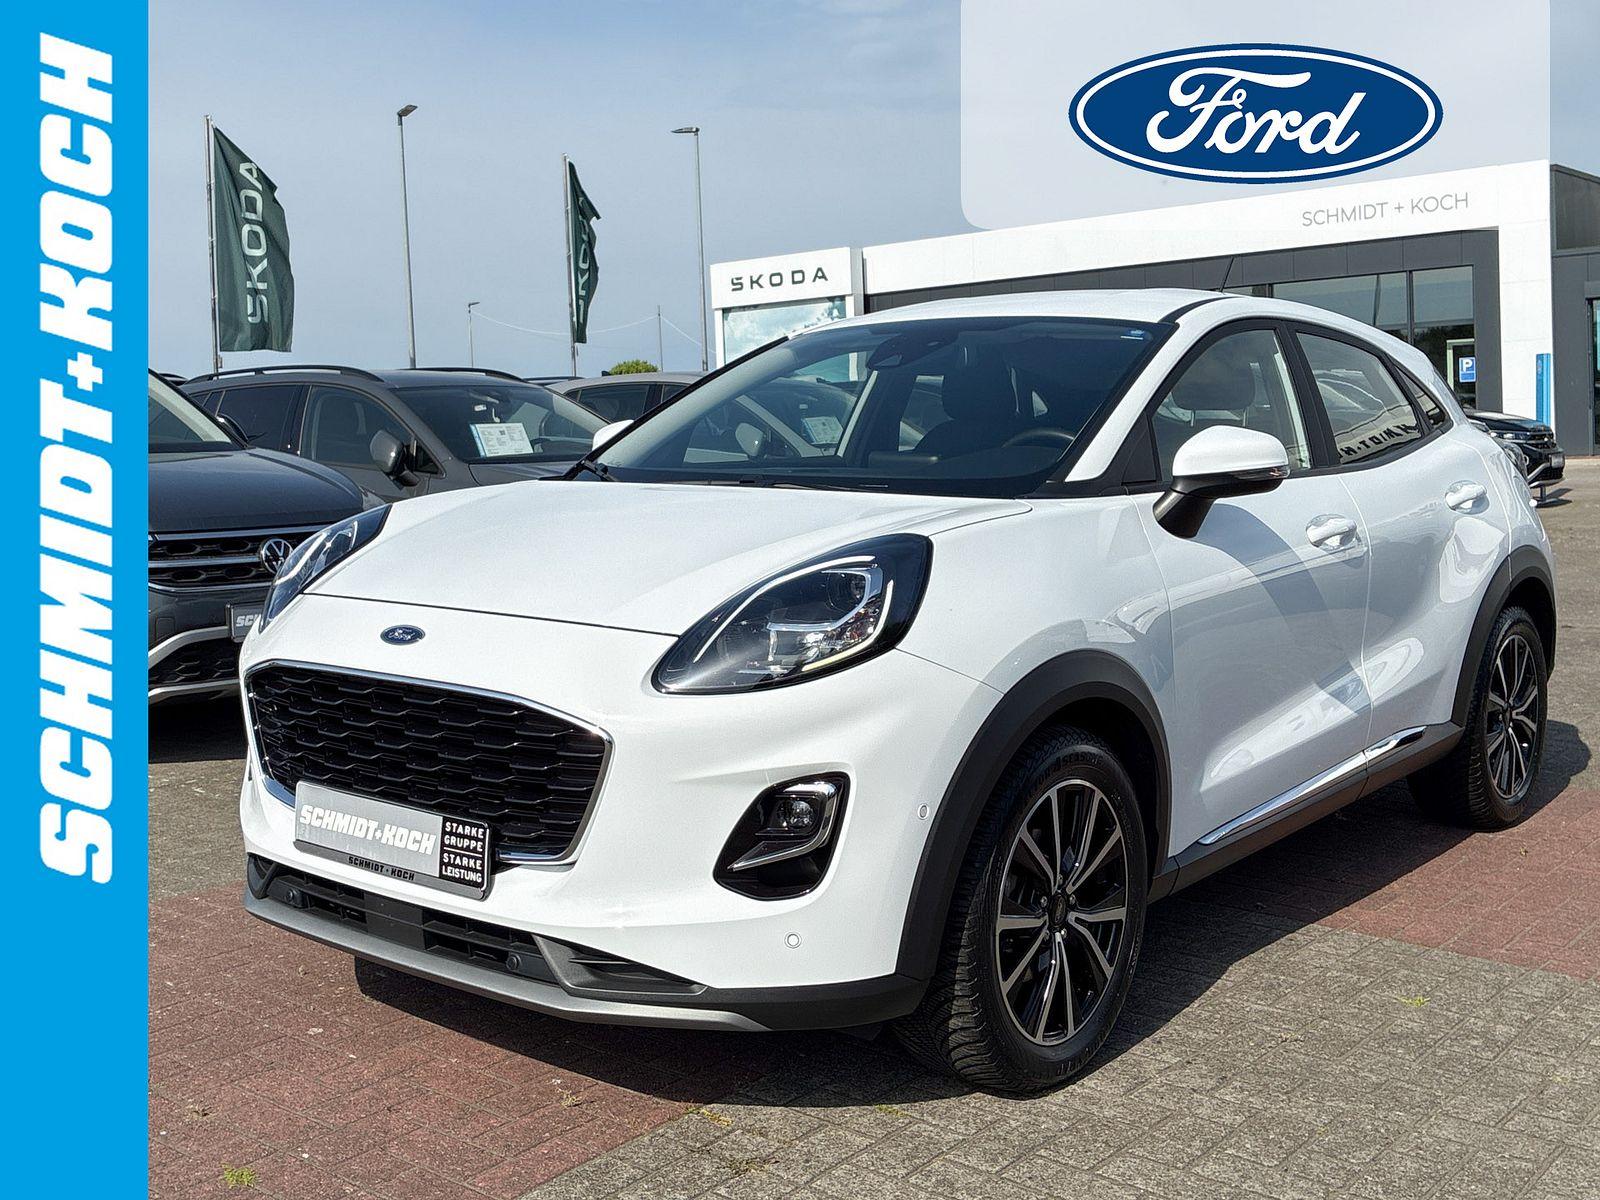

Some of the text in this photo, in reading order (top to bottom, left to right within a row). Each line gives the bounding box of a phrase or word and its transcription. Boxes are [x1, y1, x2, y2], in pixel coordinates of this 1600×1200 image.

[1301, 191, 1470, 228] SCHMIDT + KOCH
[1462, 358, 1473, 373] P
[299, 804, 437, 856] SCHMIDT+KOCH
[445, 821, 485, 839] STARKE
[444, 834, 484, 852] GRUPPE
[348, 855, 385, 873] SCHMIDT
[390, 867, 416, 881] KOCH
[442, 852, 483, 870] STARKE
[441, 864, 483, 883] LEISTUNG
